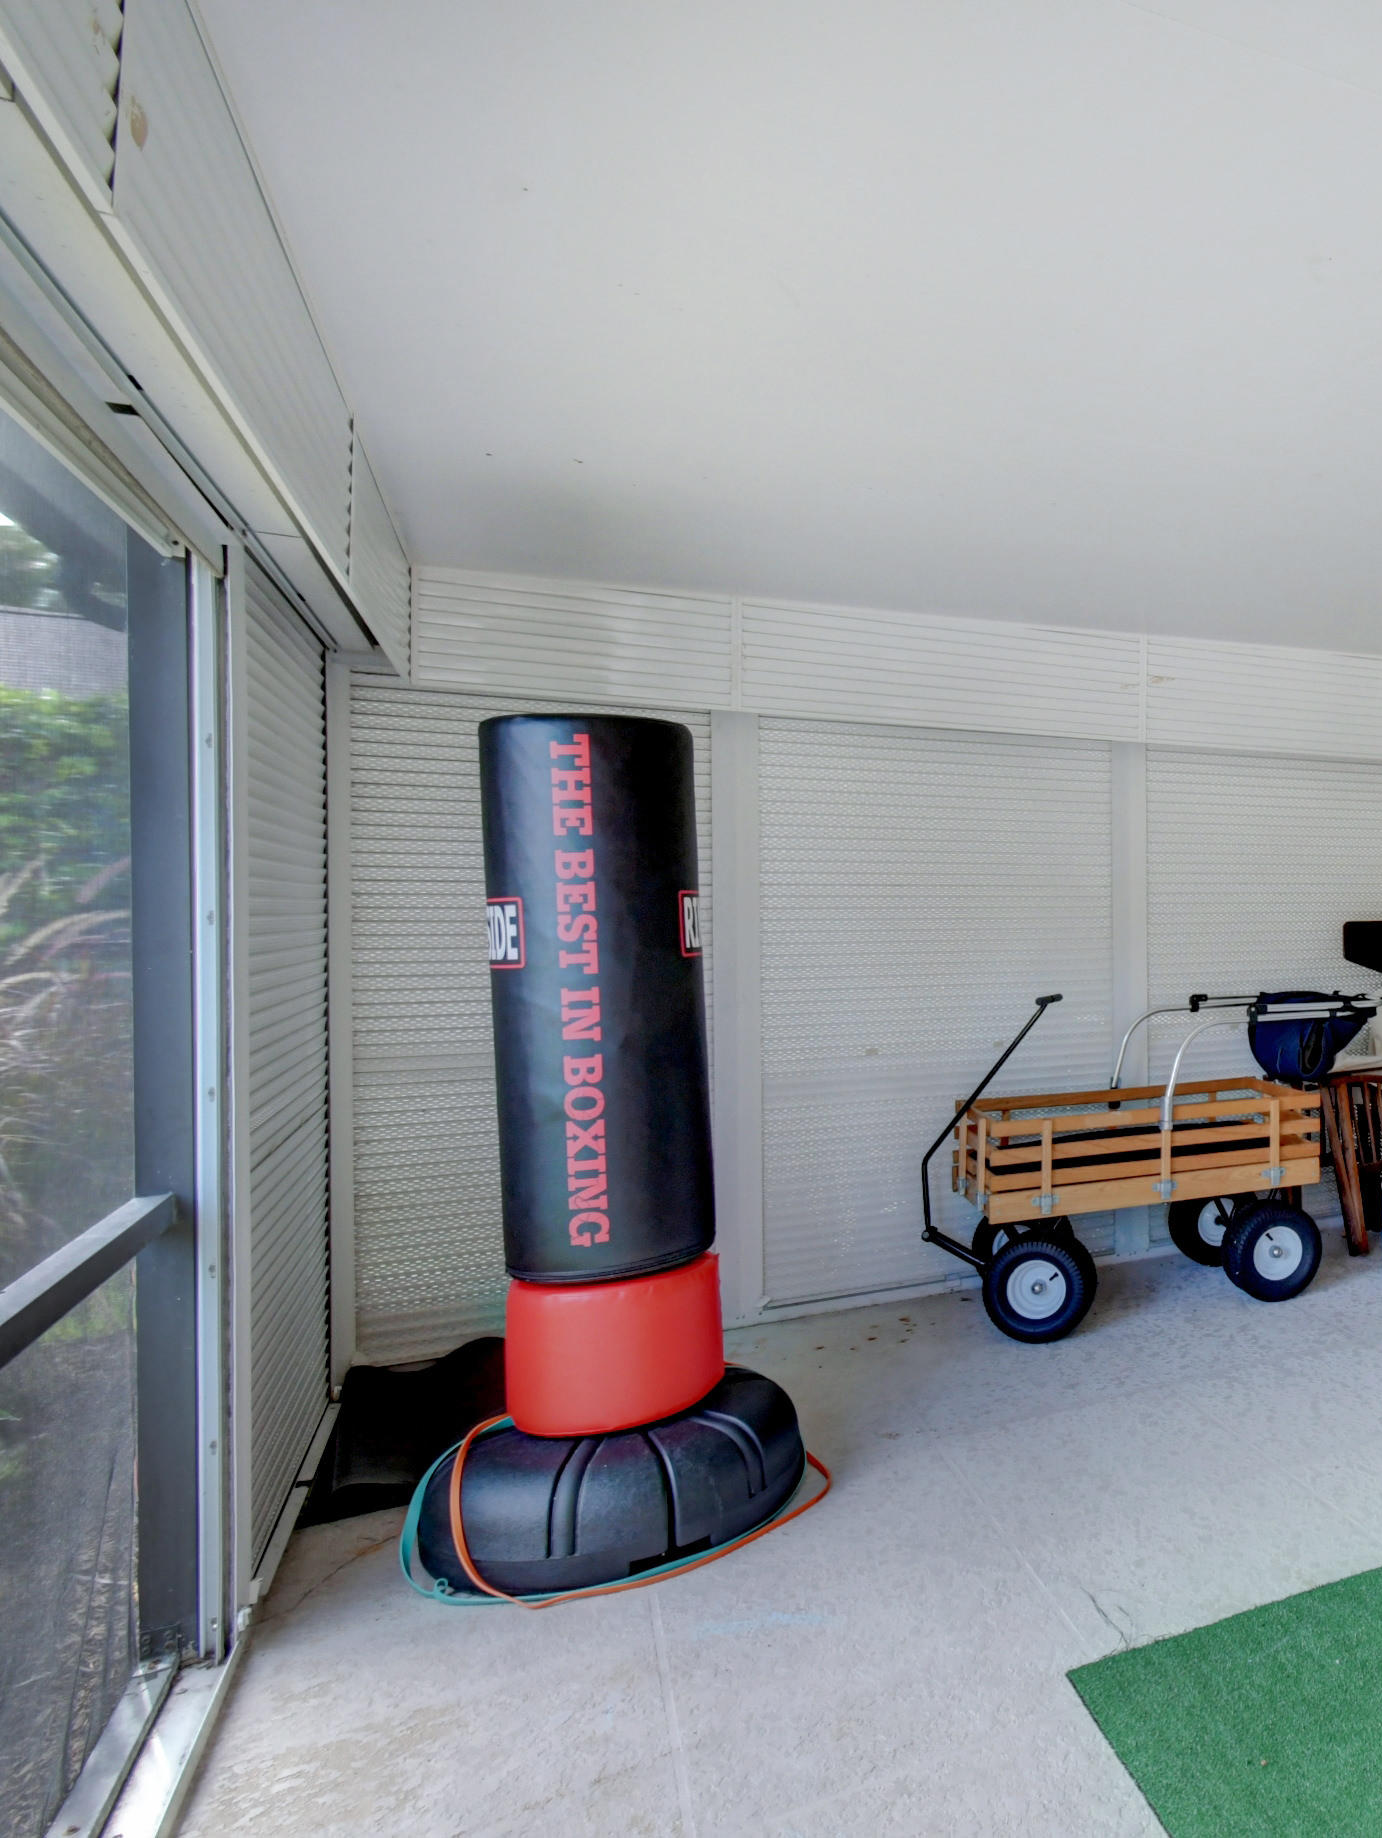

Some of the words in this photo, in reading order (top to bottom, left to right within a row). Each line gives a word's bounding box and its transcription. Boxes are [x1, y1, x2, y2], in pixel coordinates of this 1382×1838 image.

[549, 733, 594, 836] THE
[554, 848, 600, 975] BEST
[683, 896, 701, 949] RI
[560, 986, 602, 1042] IN
[563, 1053, 611, 1248] BOXING
